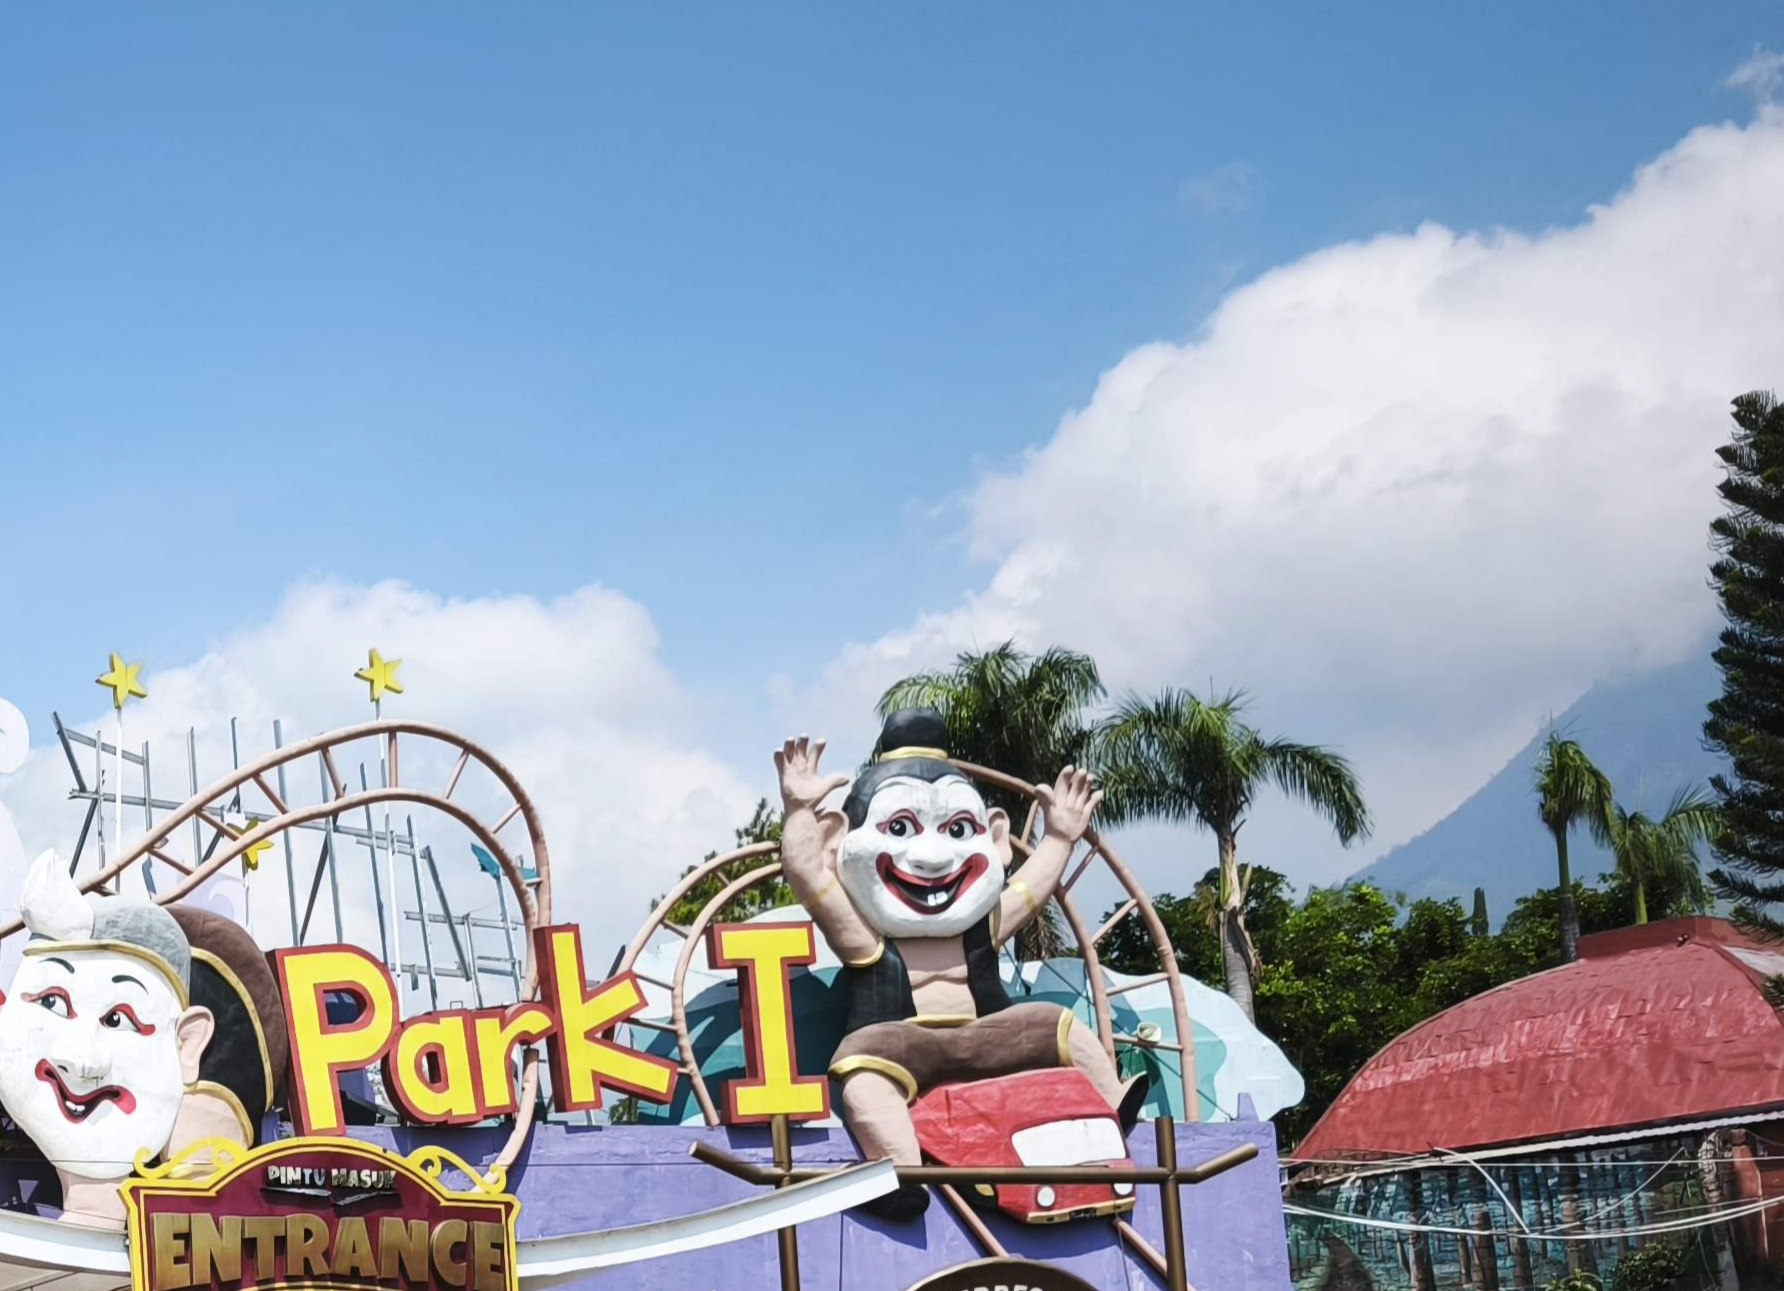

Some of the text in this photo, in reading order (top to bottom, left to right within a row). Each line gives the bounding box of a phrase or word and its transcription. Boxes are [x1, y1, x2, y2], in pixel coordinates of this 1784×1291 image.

[267, 924, 678, 1137] Park
[267, 1165, 397, 1189] PINTU MASUK
